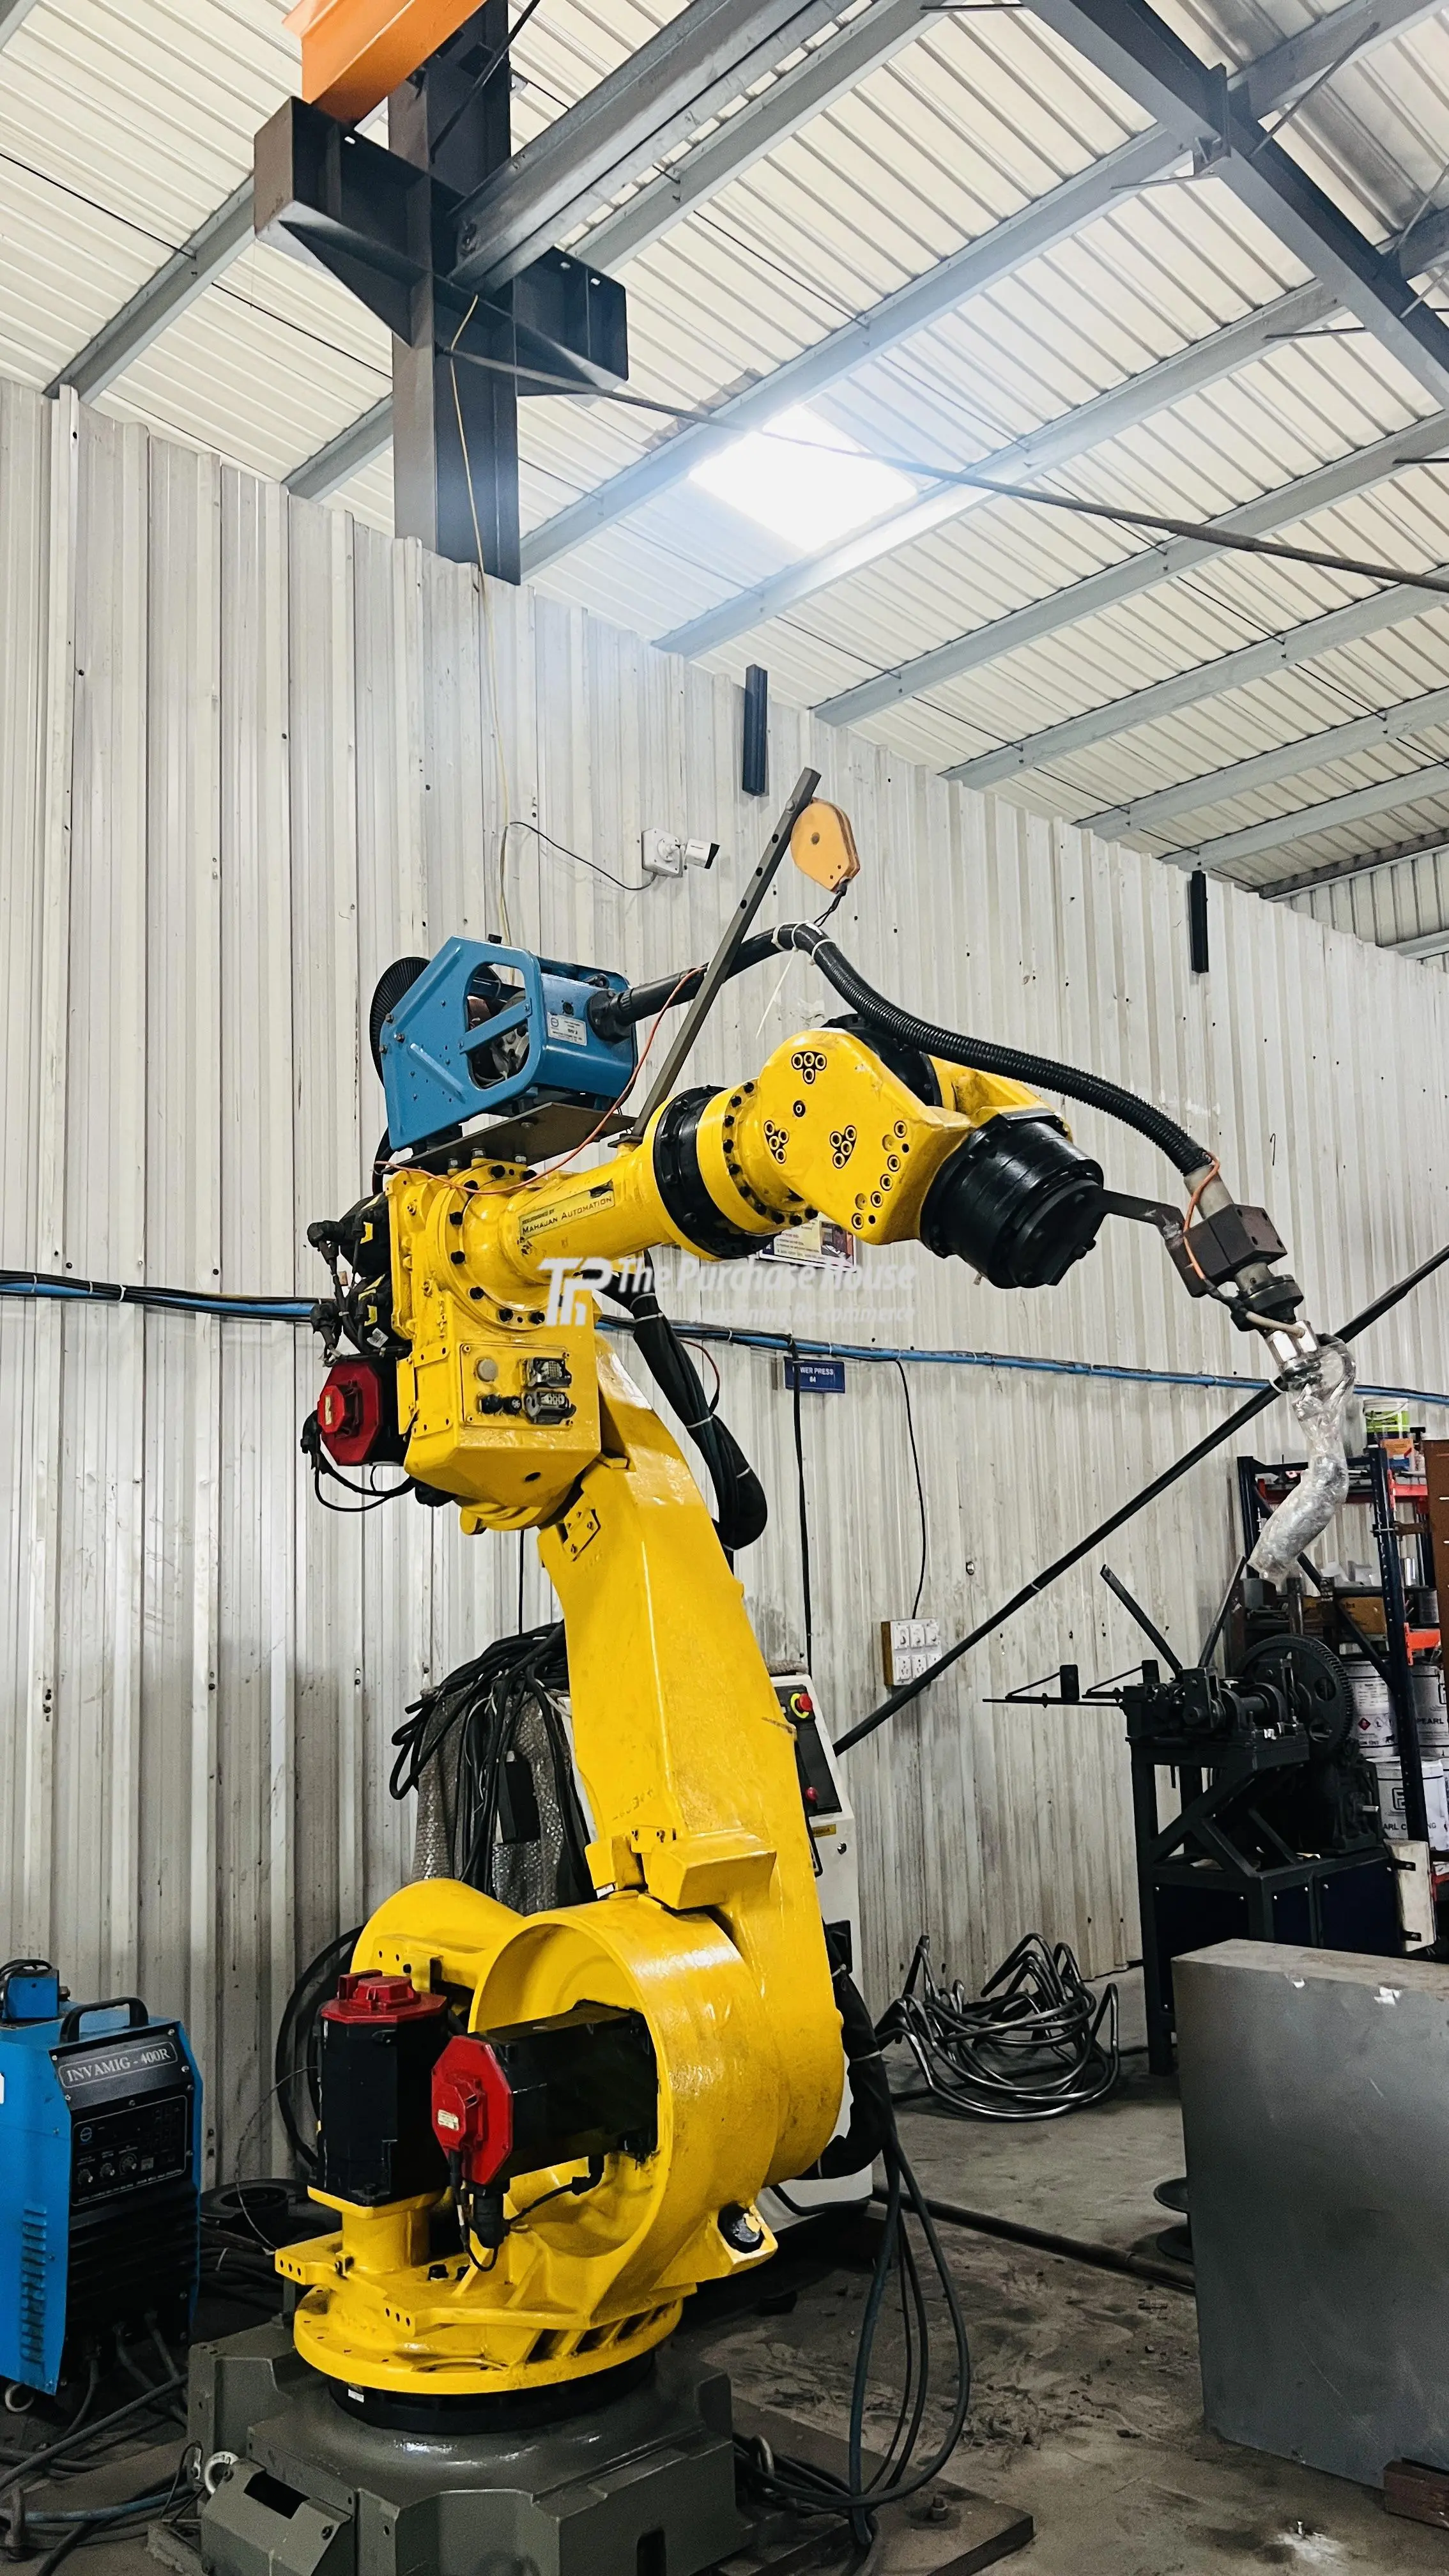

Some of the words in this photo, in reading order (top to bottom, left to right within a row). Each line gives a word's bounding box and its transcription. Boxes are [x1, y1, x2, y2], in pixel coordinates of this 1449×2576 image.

[522, 1216, 558, 1234] MAHAJAN
[562, 1196, 612, 1220] AUTOMATION
[66, 2056, 130, 2082] INVAMIG
[141, 2048, 171, 2064] 400R
